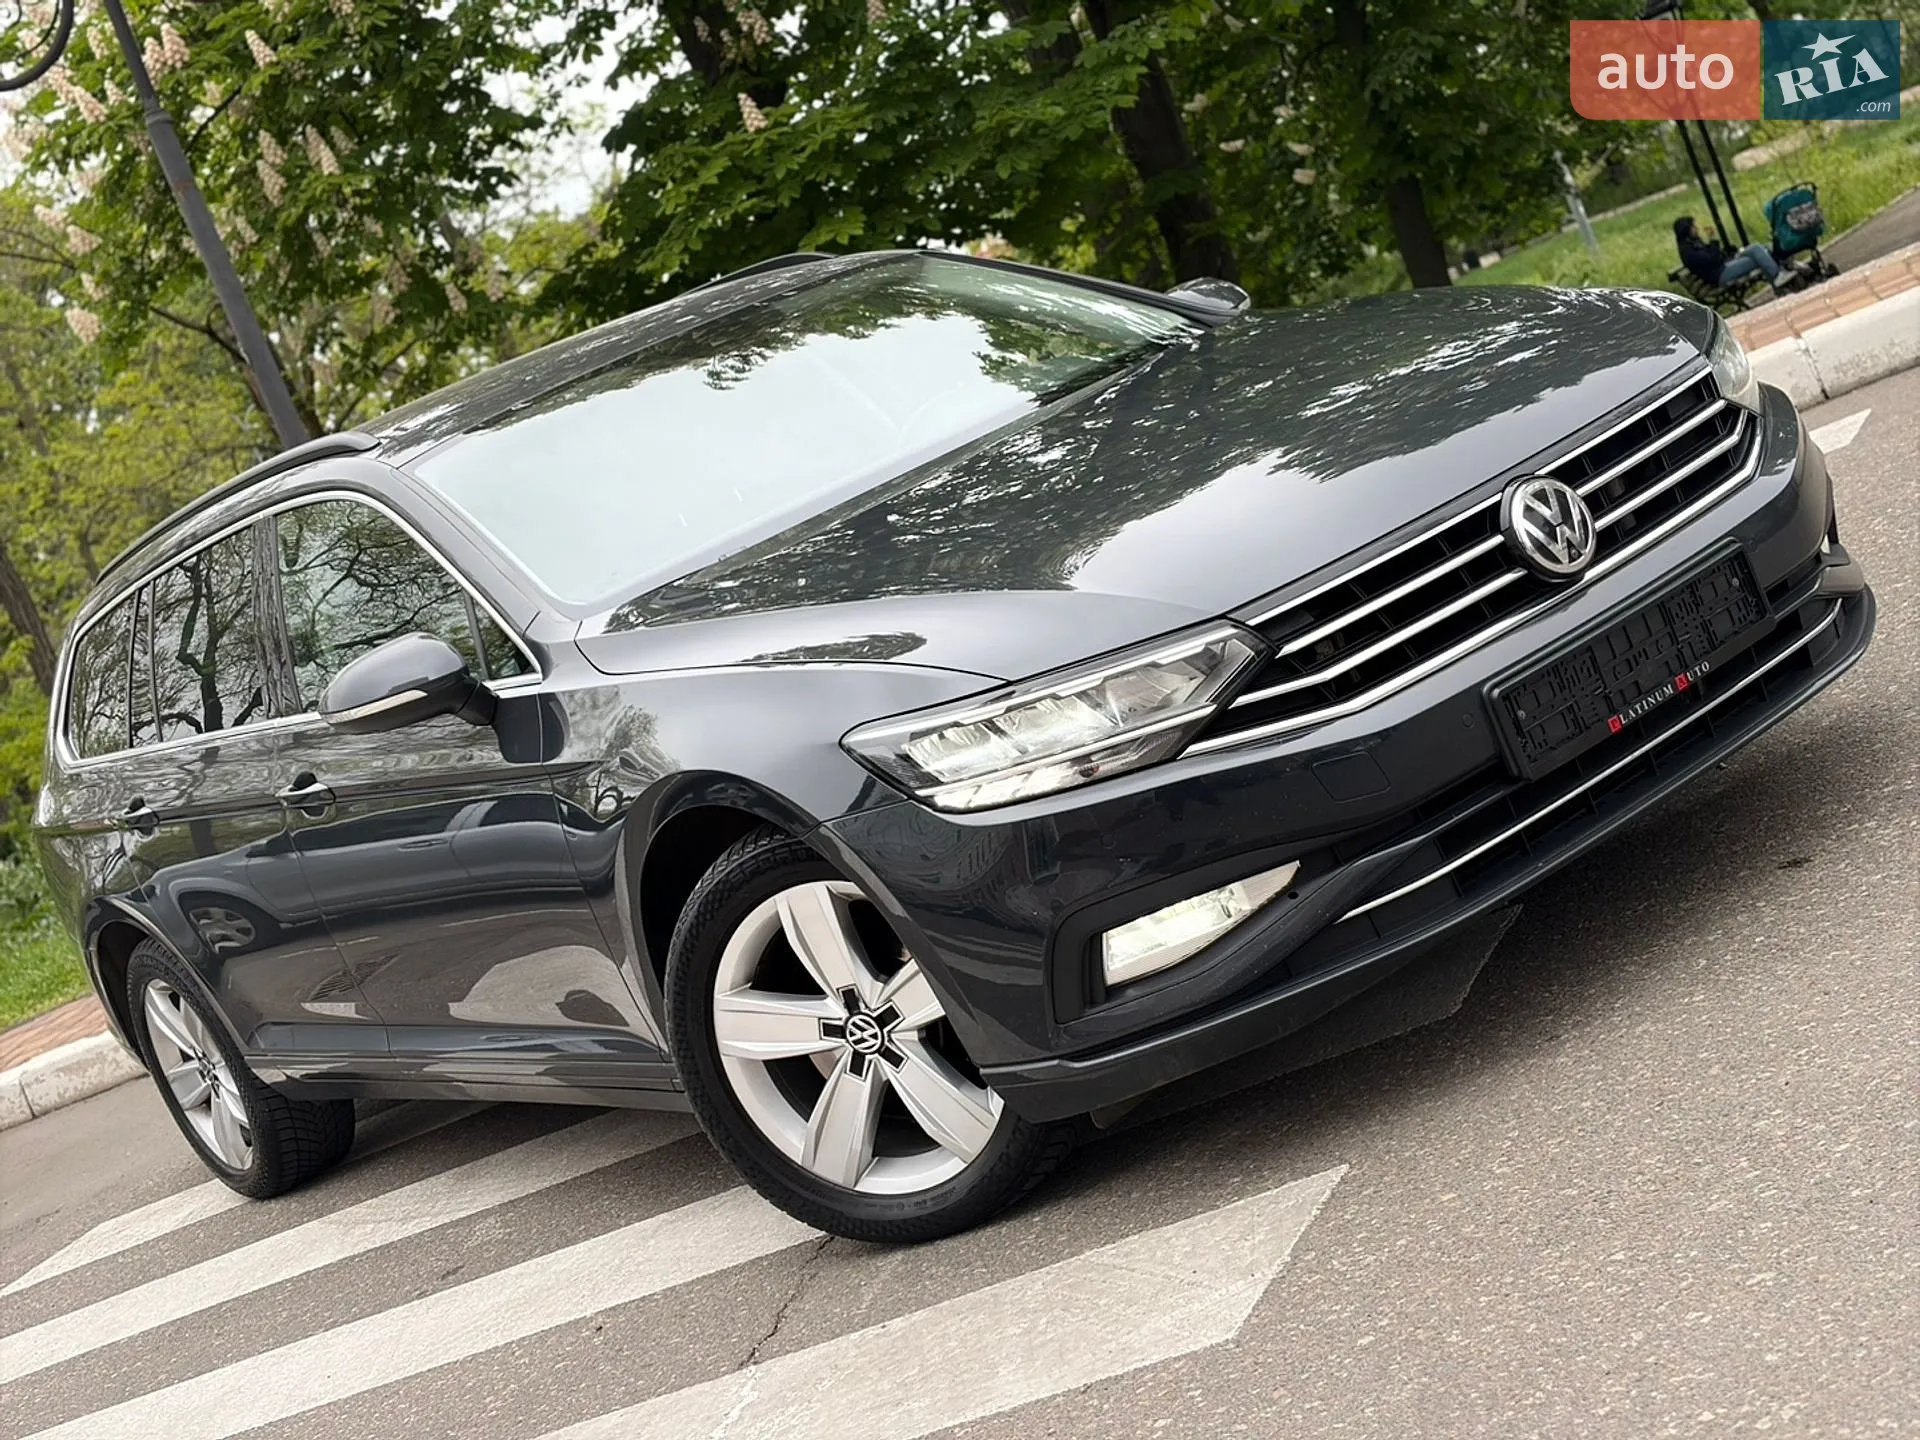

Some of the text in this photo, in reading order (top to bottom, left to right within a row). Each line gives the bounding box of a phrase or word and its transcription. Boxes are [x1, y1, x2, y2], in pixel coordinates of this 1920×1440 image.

[1513, 481, 1593, 571] VW
[1608, 661, 1710, 733] PLATINUM AUTO
